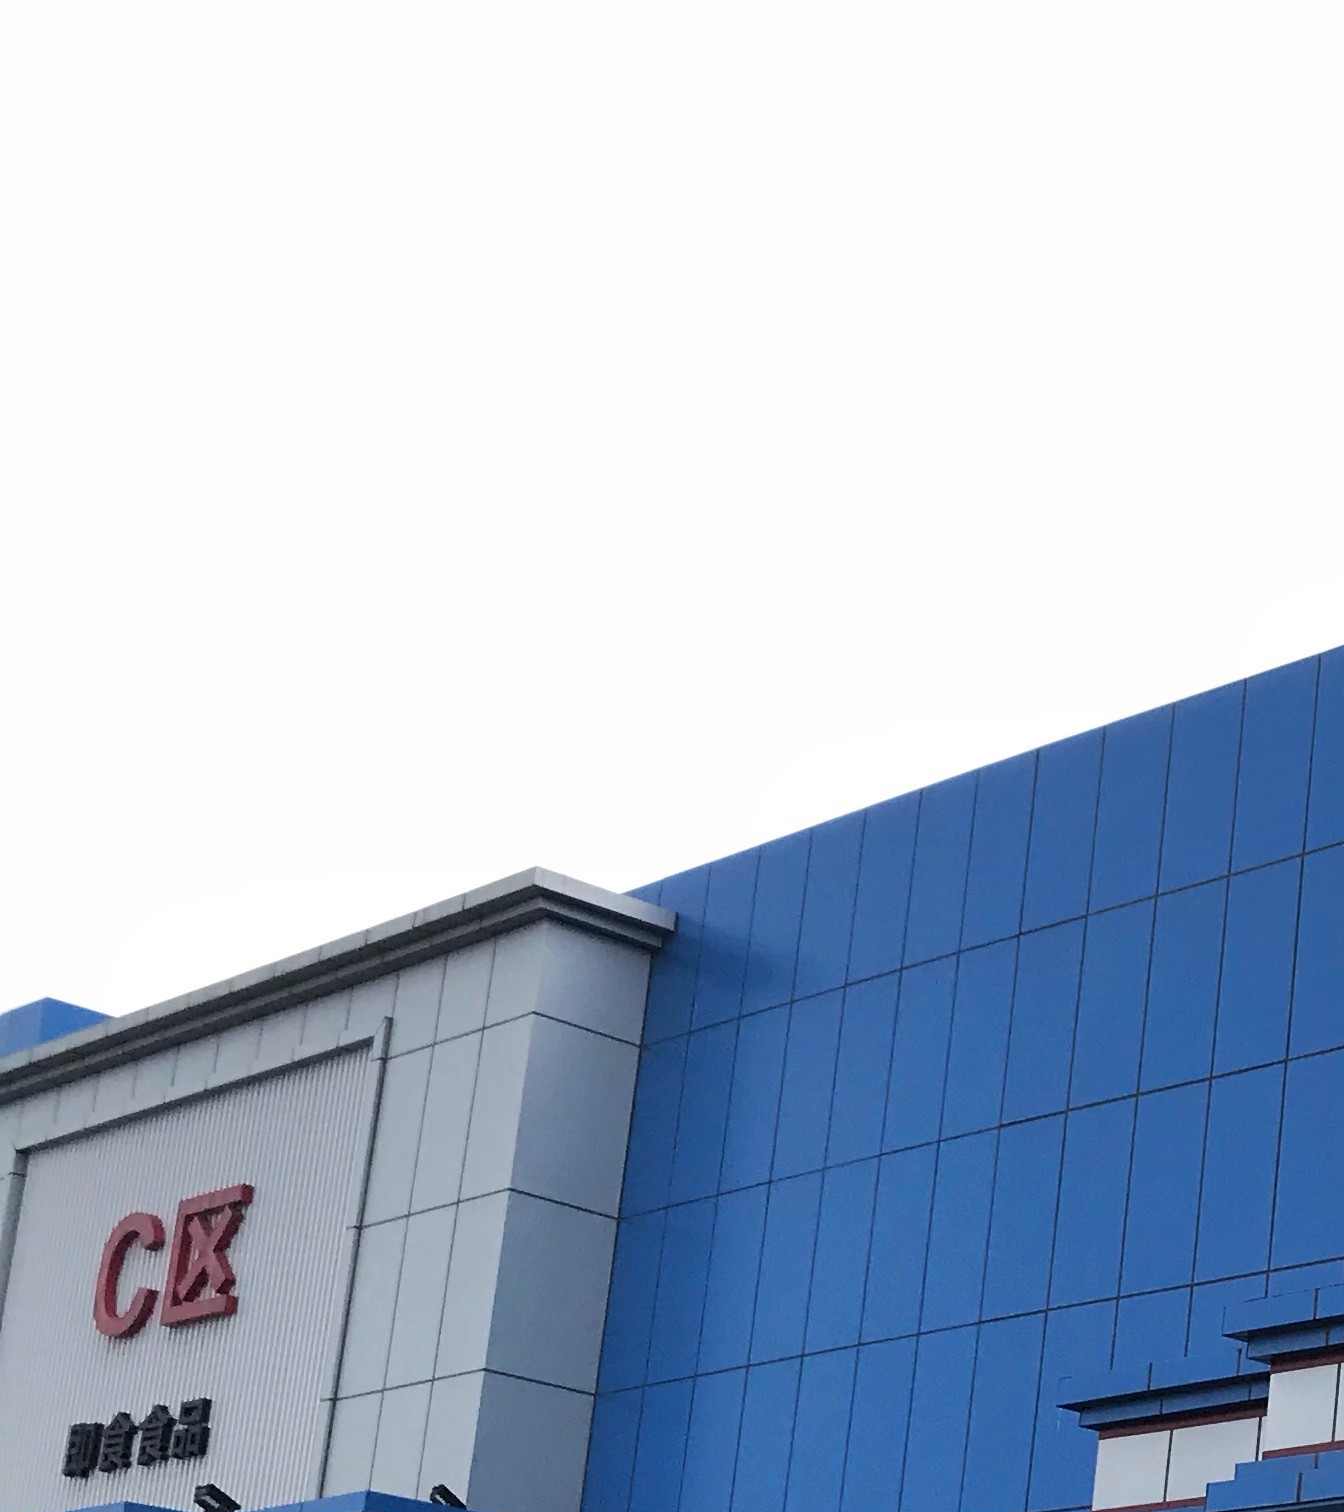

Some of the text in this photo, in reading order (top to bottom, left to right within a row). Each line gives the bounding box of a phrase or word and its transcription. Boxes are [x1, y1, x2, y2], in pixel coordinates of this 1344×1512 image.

[92, 1183, 254, 1340] C区
[64, 1398, 212, 1479] 即食食品
